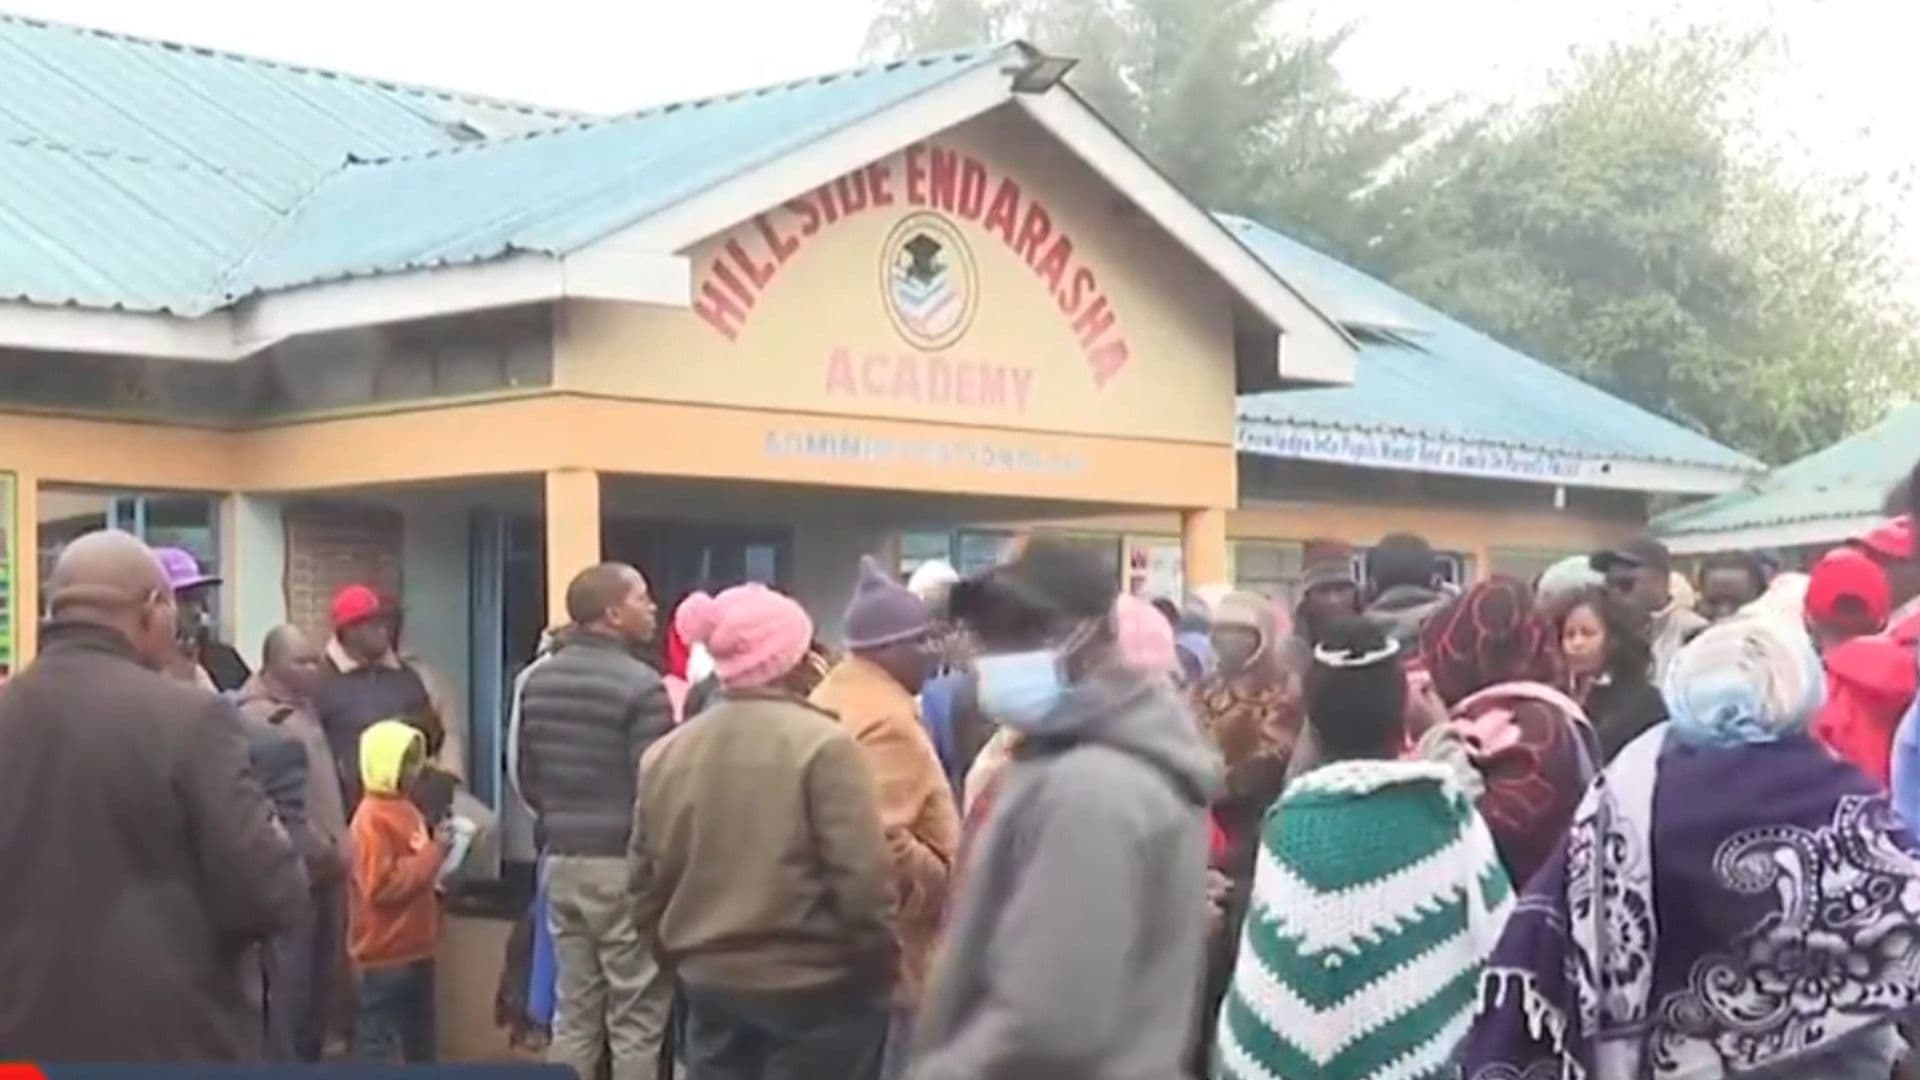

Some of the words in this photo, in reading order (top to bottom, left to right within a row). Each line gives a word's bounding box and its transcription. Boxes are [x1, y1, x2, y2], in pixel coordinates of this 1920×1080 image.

[693, 160, 895, 342] HILLSIDE
[905, 143, 1129, 388] ENDARASHA
[824, 346, 1034, 414] ACADEMY
